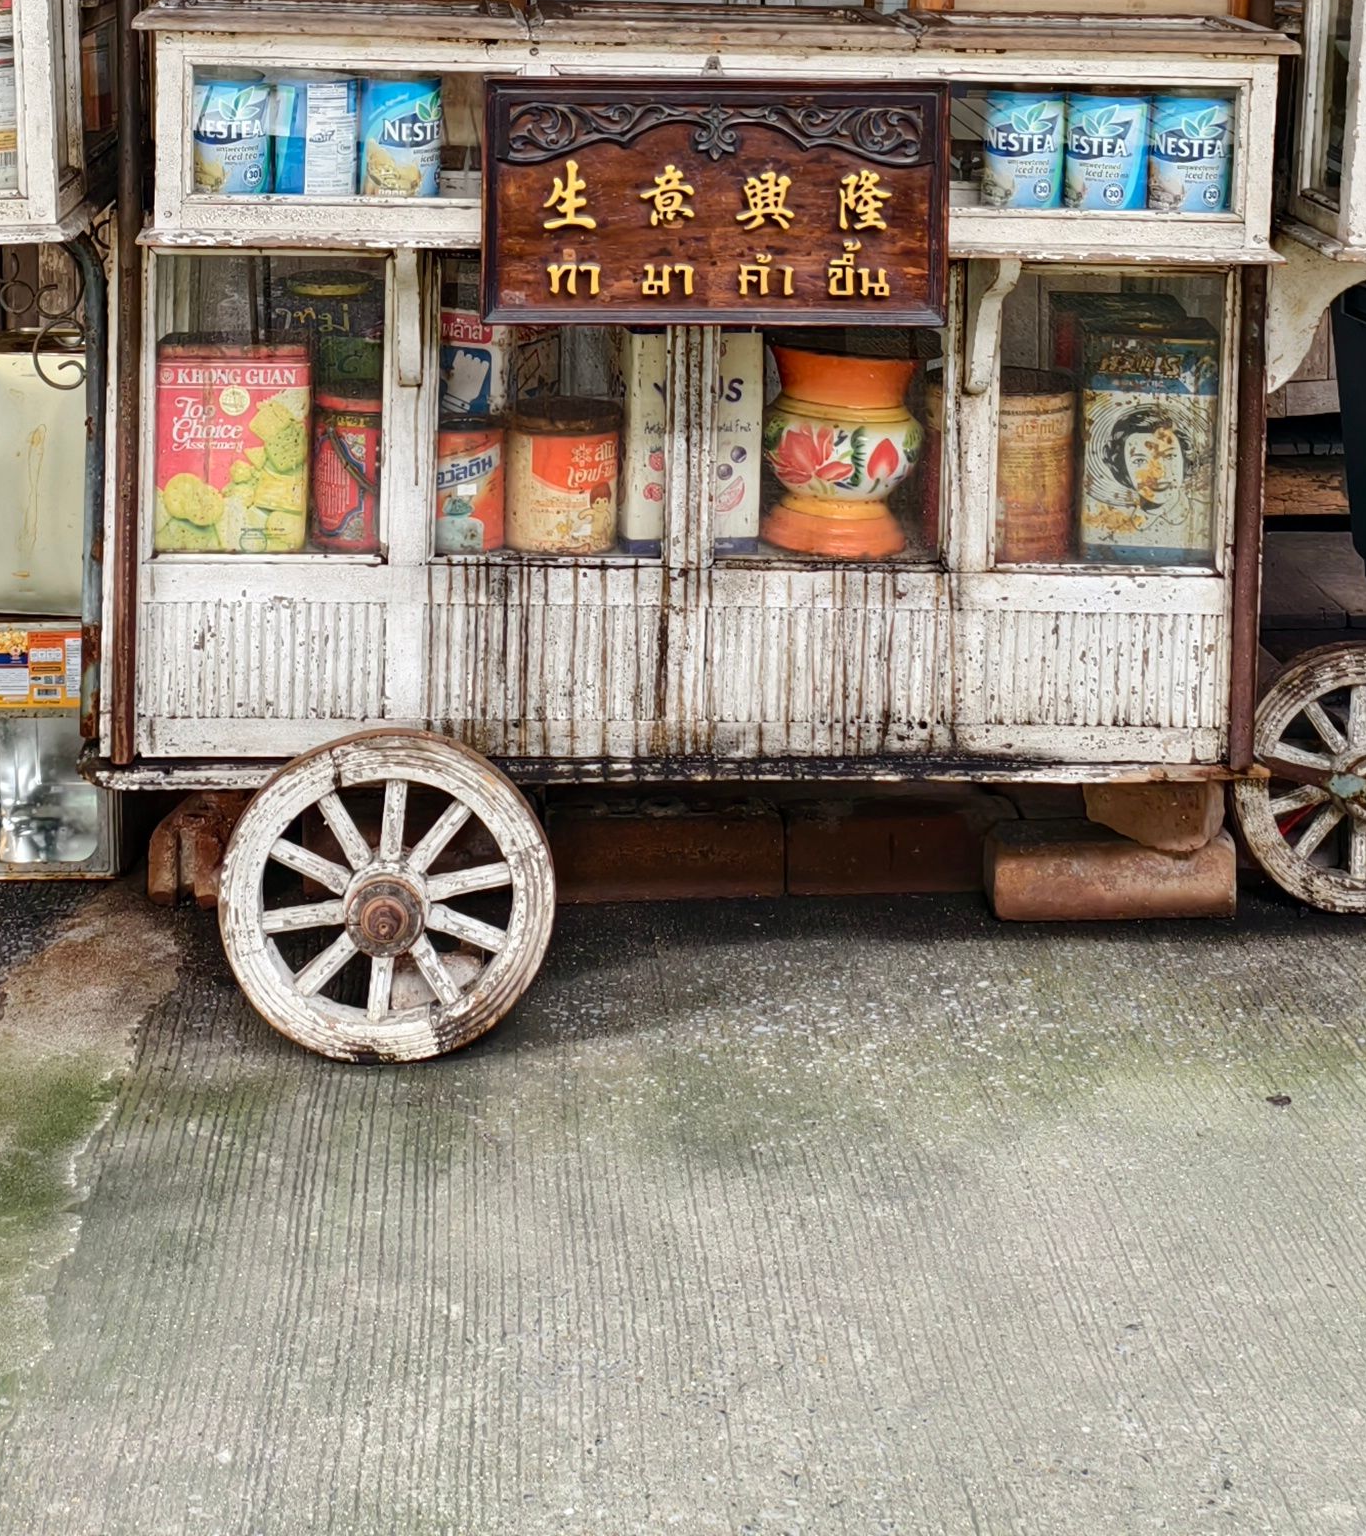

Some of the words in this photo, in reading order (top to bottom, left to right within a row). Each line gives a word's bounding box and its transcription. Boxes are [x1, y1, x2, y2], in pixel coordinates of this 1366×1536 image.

[383, 119, 442, 141] NESTE
[987, 127, 1055, 153] NESTEA
[1155, 133, 1225, 159] NESTEA
[543, 160, 892, 231] 生意興隆
[176, 368, 242, 385] KHONG
[245, 368, 297, 385] GUAN
[172, 416, 244, 443] Choice
